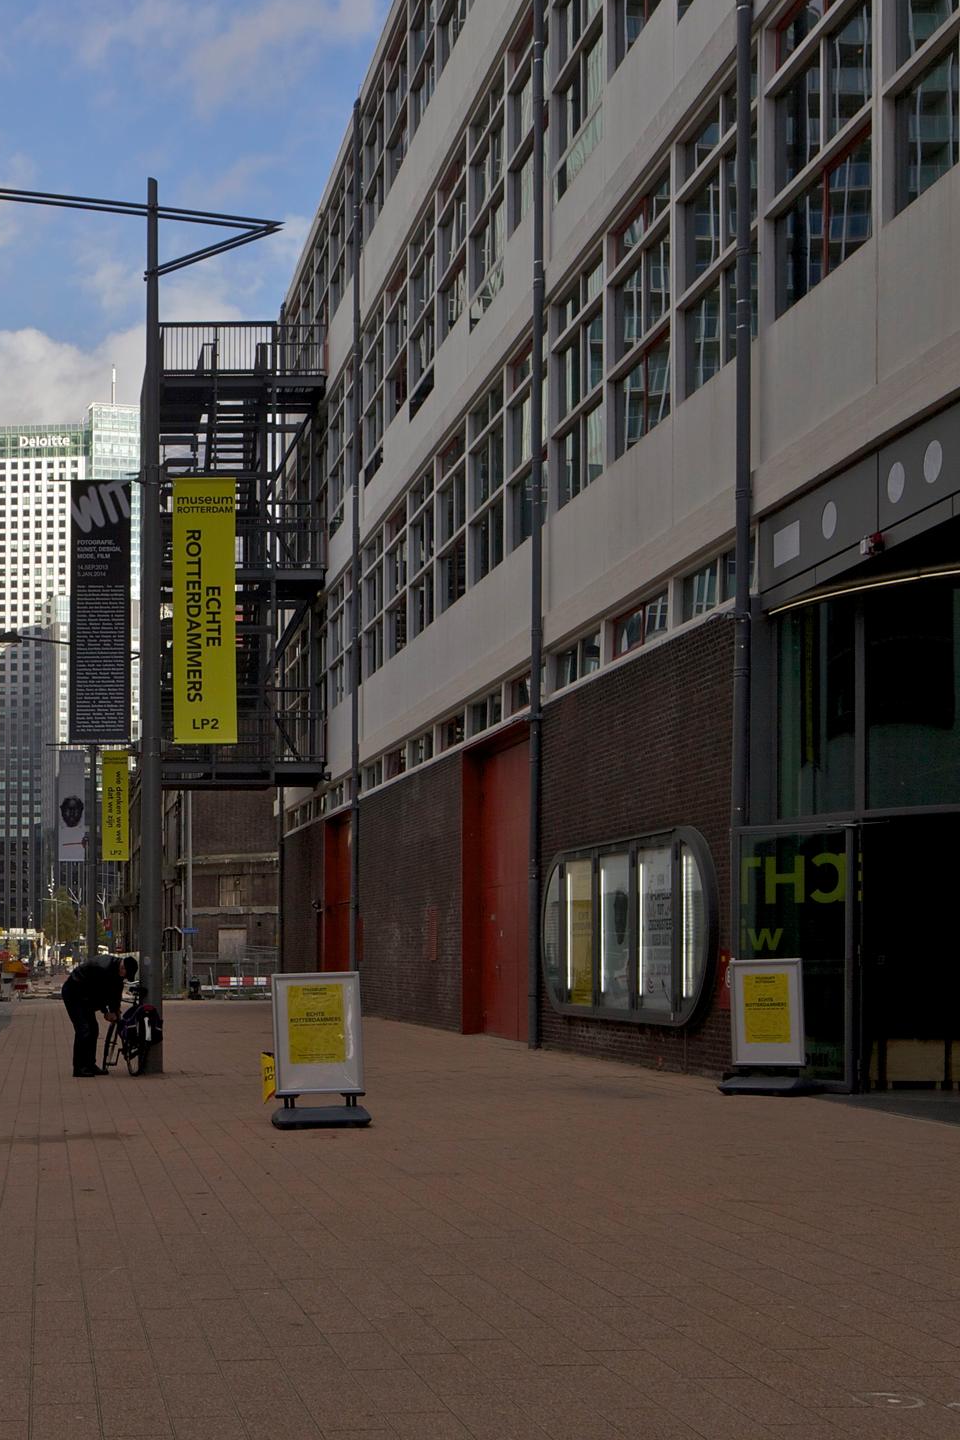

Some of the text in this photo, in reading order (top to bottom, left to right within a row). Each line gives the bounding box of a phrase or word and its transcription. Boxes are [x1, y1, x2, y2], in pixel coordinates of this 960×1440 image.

[19, 435, 71, 447] Deloitte
[176, 495, 233, 505] museum
[176, 506, 233, 514] ROTTERDAM
[185, 529, 203, 703] ROTTERDAMMERS
[205, 586, 222, 647] ECHTE
[192, 719, 220, 730] LP2
[115, 771, 123, 785] wie
[107, 786, 115, 800] dat
[115, 786, 124, 815] denken
[115, 816, 123, 829] we
